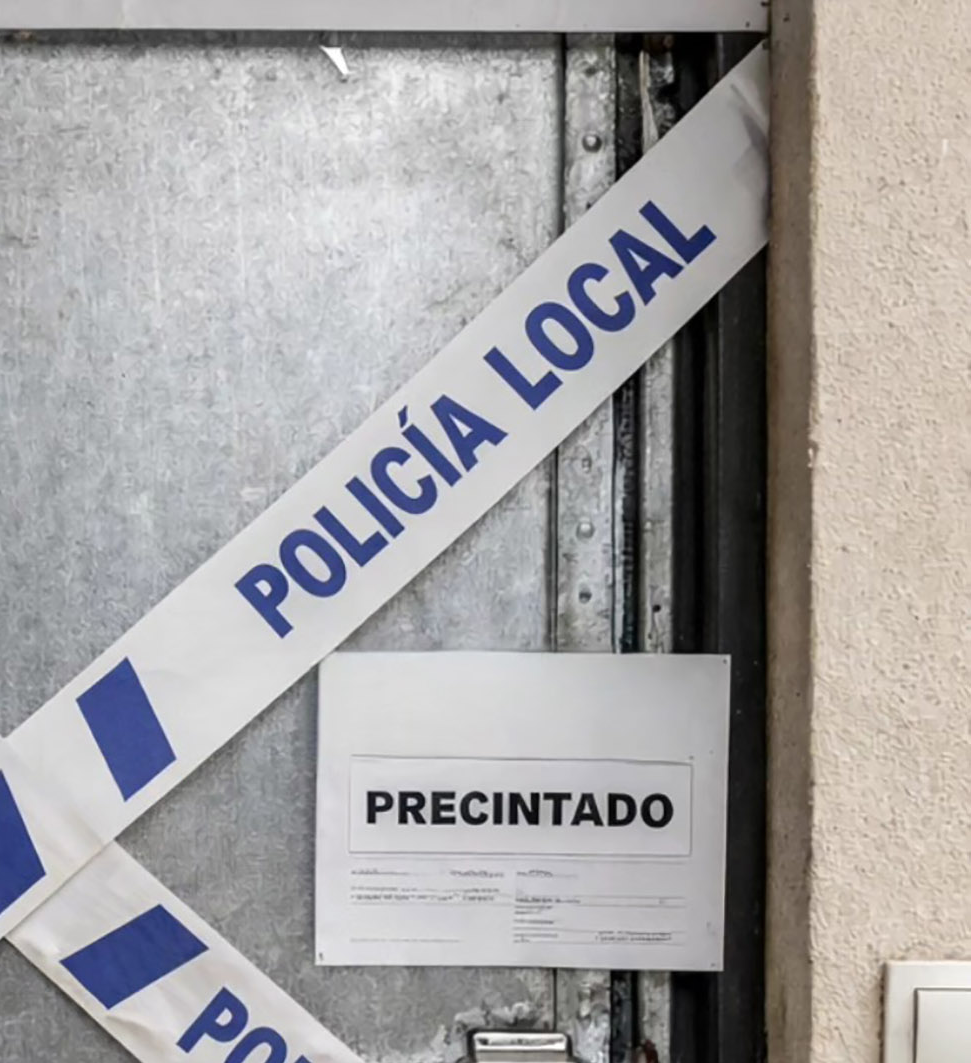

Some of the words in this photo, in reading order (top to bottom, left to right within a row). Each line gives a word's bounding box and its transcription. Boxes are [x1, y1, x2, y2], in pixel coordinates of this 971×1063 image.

[234, 394, 508, 638] POLICÍA
[483, 200, 717, 411] LOCAL
[366, 790, 674, 829] PRECINTADO
